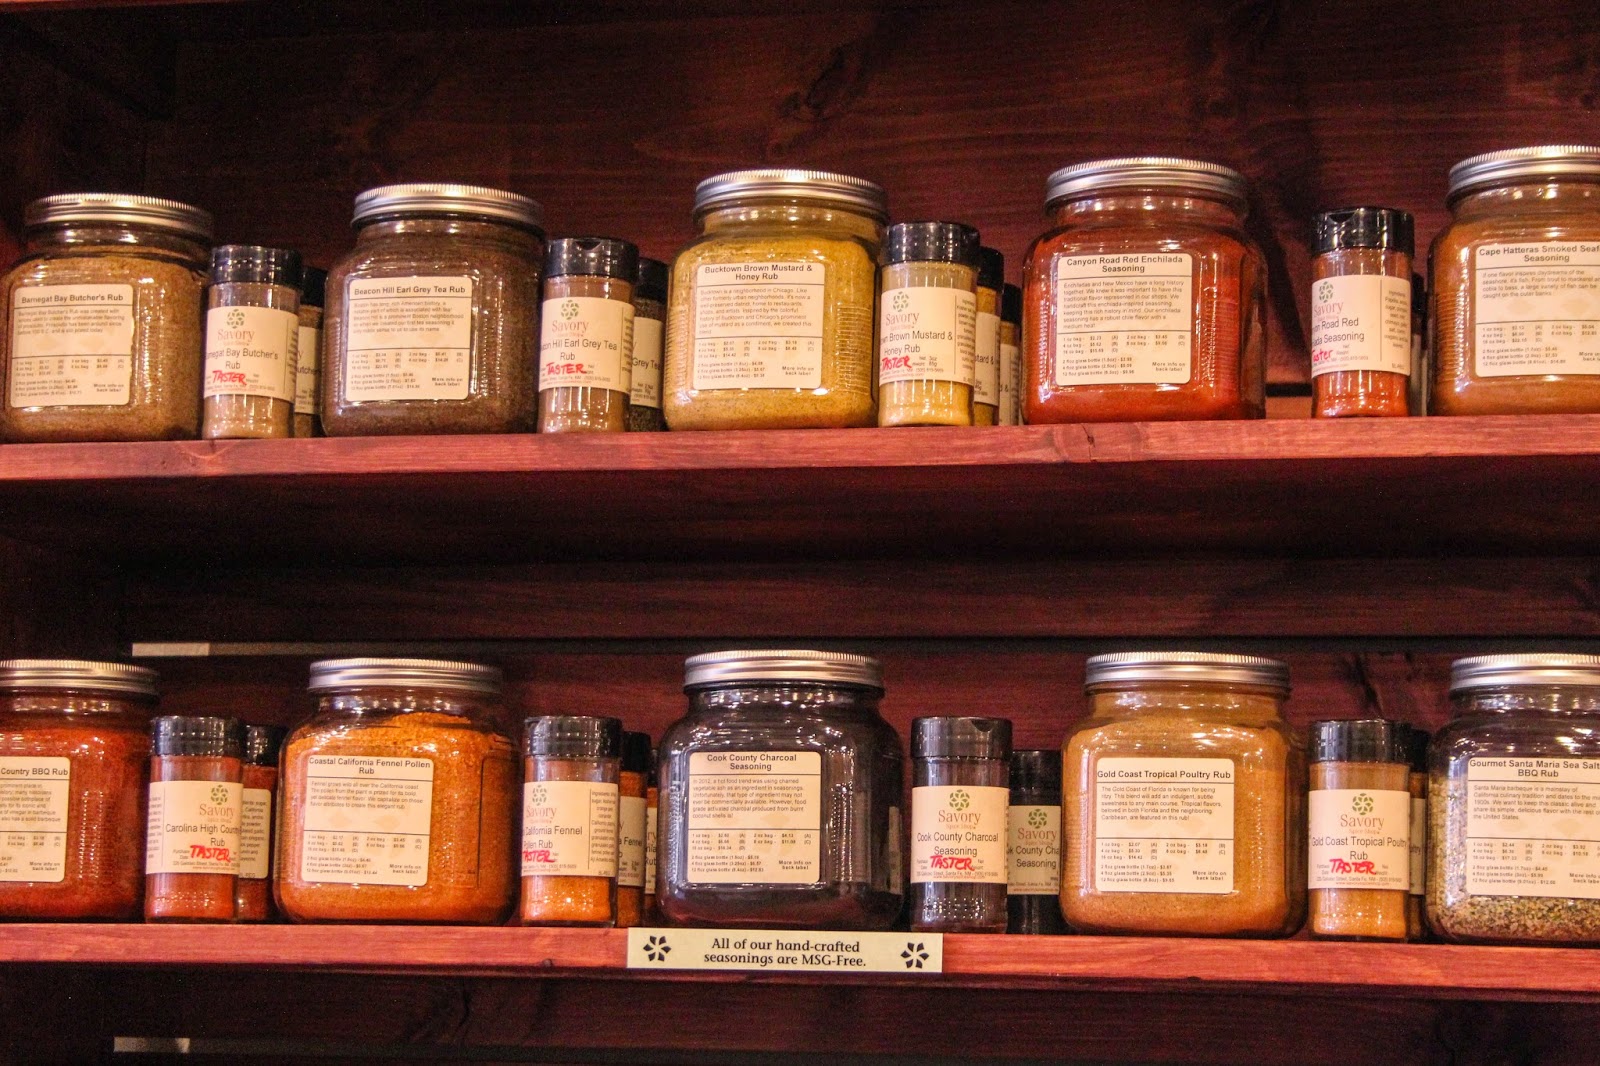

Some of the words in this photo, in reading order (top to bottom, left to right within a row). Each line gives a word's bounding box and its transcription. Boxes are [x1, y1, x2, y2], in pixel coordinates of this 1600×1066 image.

[1479, 248, 1500, 256] Cape
[1314, 302, 1343, 318] Savory
[886, 313, 920, 326] Savory
[1322, 320, 1339, 329] Road
[1342, 318, 1358, 326] Red
[552, 321, 589, 333] Savory
[218, 329, 254, 340] Savory
[890, 332, 910, 341] Brown
[912, 331, 945, 339] Mustard
[948, 332, 952, 340] &
[1324, 332, 1364, 343] Seasoning
[553, 340, 562, 348] Hill
[565, 339, 579, 347] Earl
[582, 339, 601, 350] Grey
[604, 340, 617, 350] Tea
[904, 344, 920, 353] Rub
[226, 348, 240, 357] Bay
[243, 348, 278, 360] Butcher's
[560, 352, 575, 360] Rub
[226, 361, 240, 369] Rub
[546, 362, 587, 375] TASTER
[632, 358, 649, 368] Grey
[212, 370, 247, 385] TASTER
[338, 758, 373, 766] California
[376, 759, 402, 767] Fennel
[707, 754, 727, 762] Cook
[729, 754, 757, 762] County
[730, 763, 771, 771] Seasoning
[1563, 761, 1579, 769] Sea
[1, 768, 30, 776] Country
[1144, 771, 1177, 779] Tropical
[1180, 771, 1210, 780] Poultry
[1518, 769, 1538, 777] BBQ
[200, 804, 234, 816] Savory
[526, 806, 557, 819] Savory
[939, 809, 981, 824] Savory
[1340, 814, 1384, 830] Savory
[166, 824, 197, 833] Carolina
[200, 824, 218, 834] High
[554, 826, 582, 835] Fennel
[917, 832, 931, 842] Cook
[934, 832, 962, 843] County
[965, 832, 998, 842] Charcoal
[1018, 828, 1057, 842] Savory
[211, 838, 225, 847] Rub
[538, 840, 553, 849] Rub
[624, 837, 643, 846] Fenne
[1326, 837, 1348, 846] Coast
[1351, 836, 1385, 848] Tropical
[190, 845, 231, 863] TASTER
[934, 846, 977, 857] Seasoning
[1016, 846, 1043, 856] County
[1350, 851, 1368, 860] Rub
[930, 855, 975, 871] TASTER
[1016, 860, 1056, 869] Seasoning
[1330, 859, 1376, 875] TASTER
[712, 939, 730, 949] All
[734, 939, 748, 950] of
[750, 941, 772, 950] our
[776, 940, 860, 953] hand-crafted
[704, 953, 774, 966] seasonings
[777, 955, 797, 964] are
[801, 954, 866, 967] MSG-Free.
